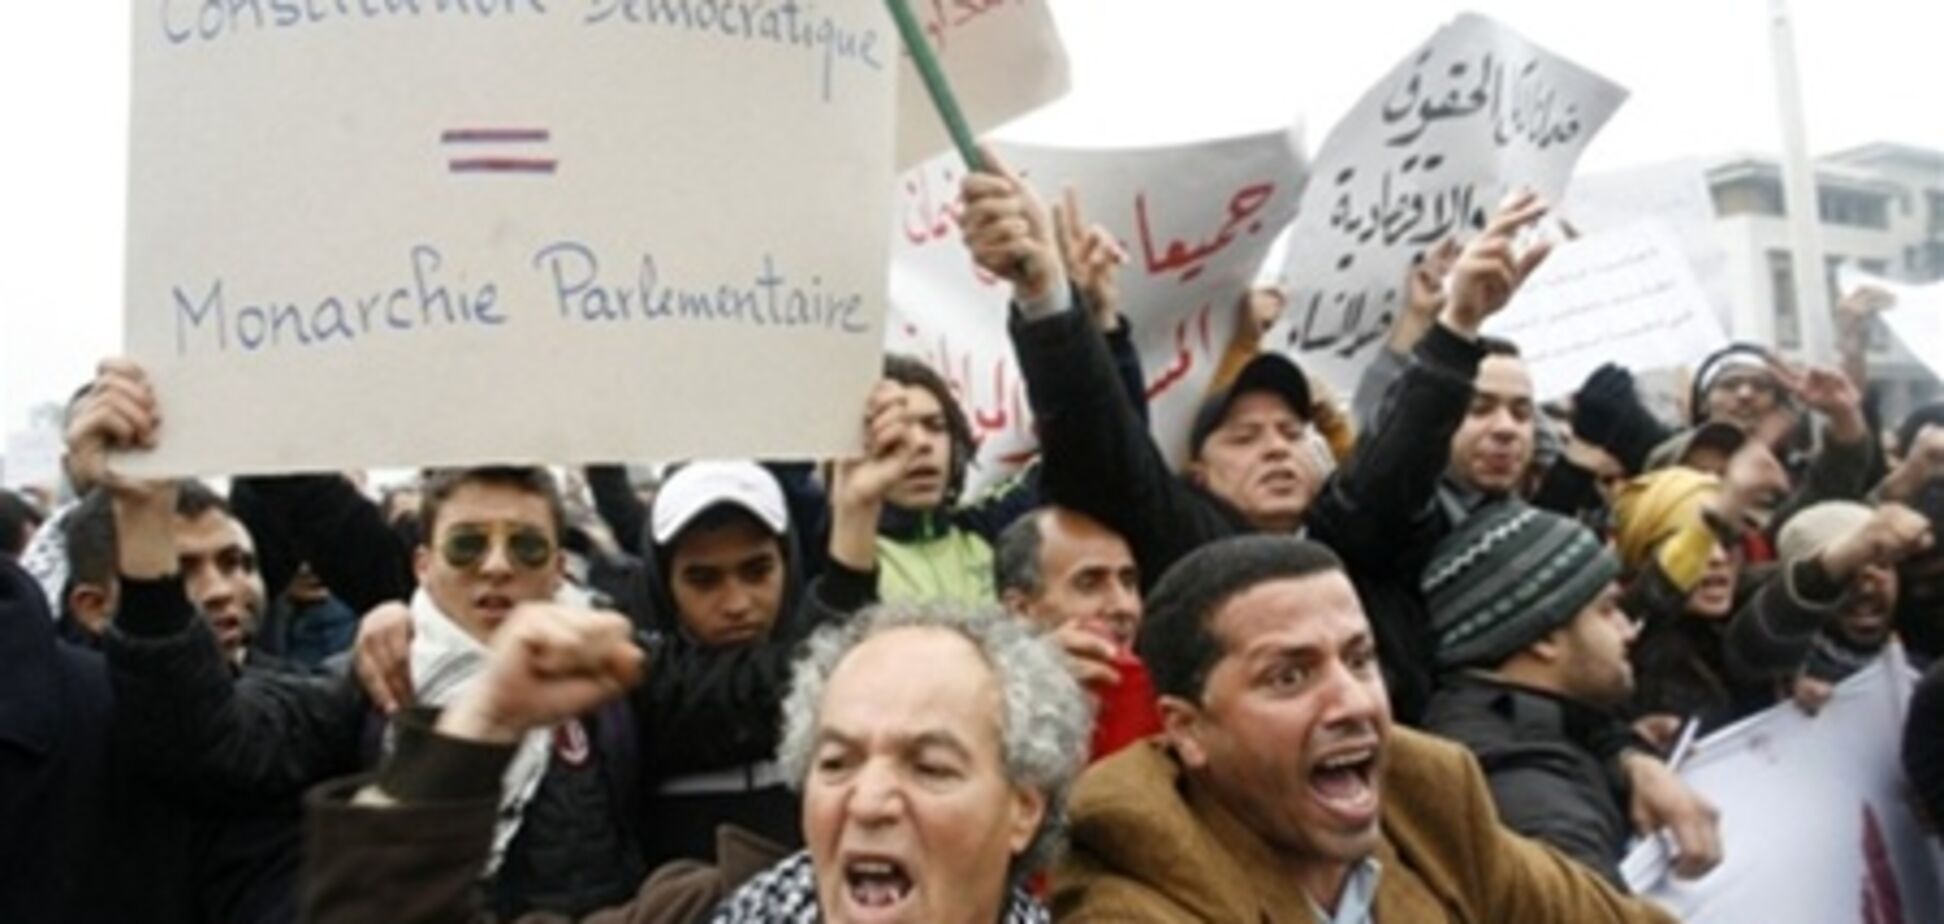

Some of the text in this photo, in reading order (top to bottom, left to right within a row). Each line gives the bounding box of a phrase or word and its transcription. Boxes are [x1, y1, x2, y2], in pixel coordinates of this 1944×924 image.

[1135, 180, 1275, 283] جميعا
[170, 242, 870, 355] Monarchie Parlementaire
